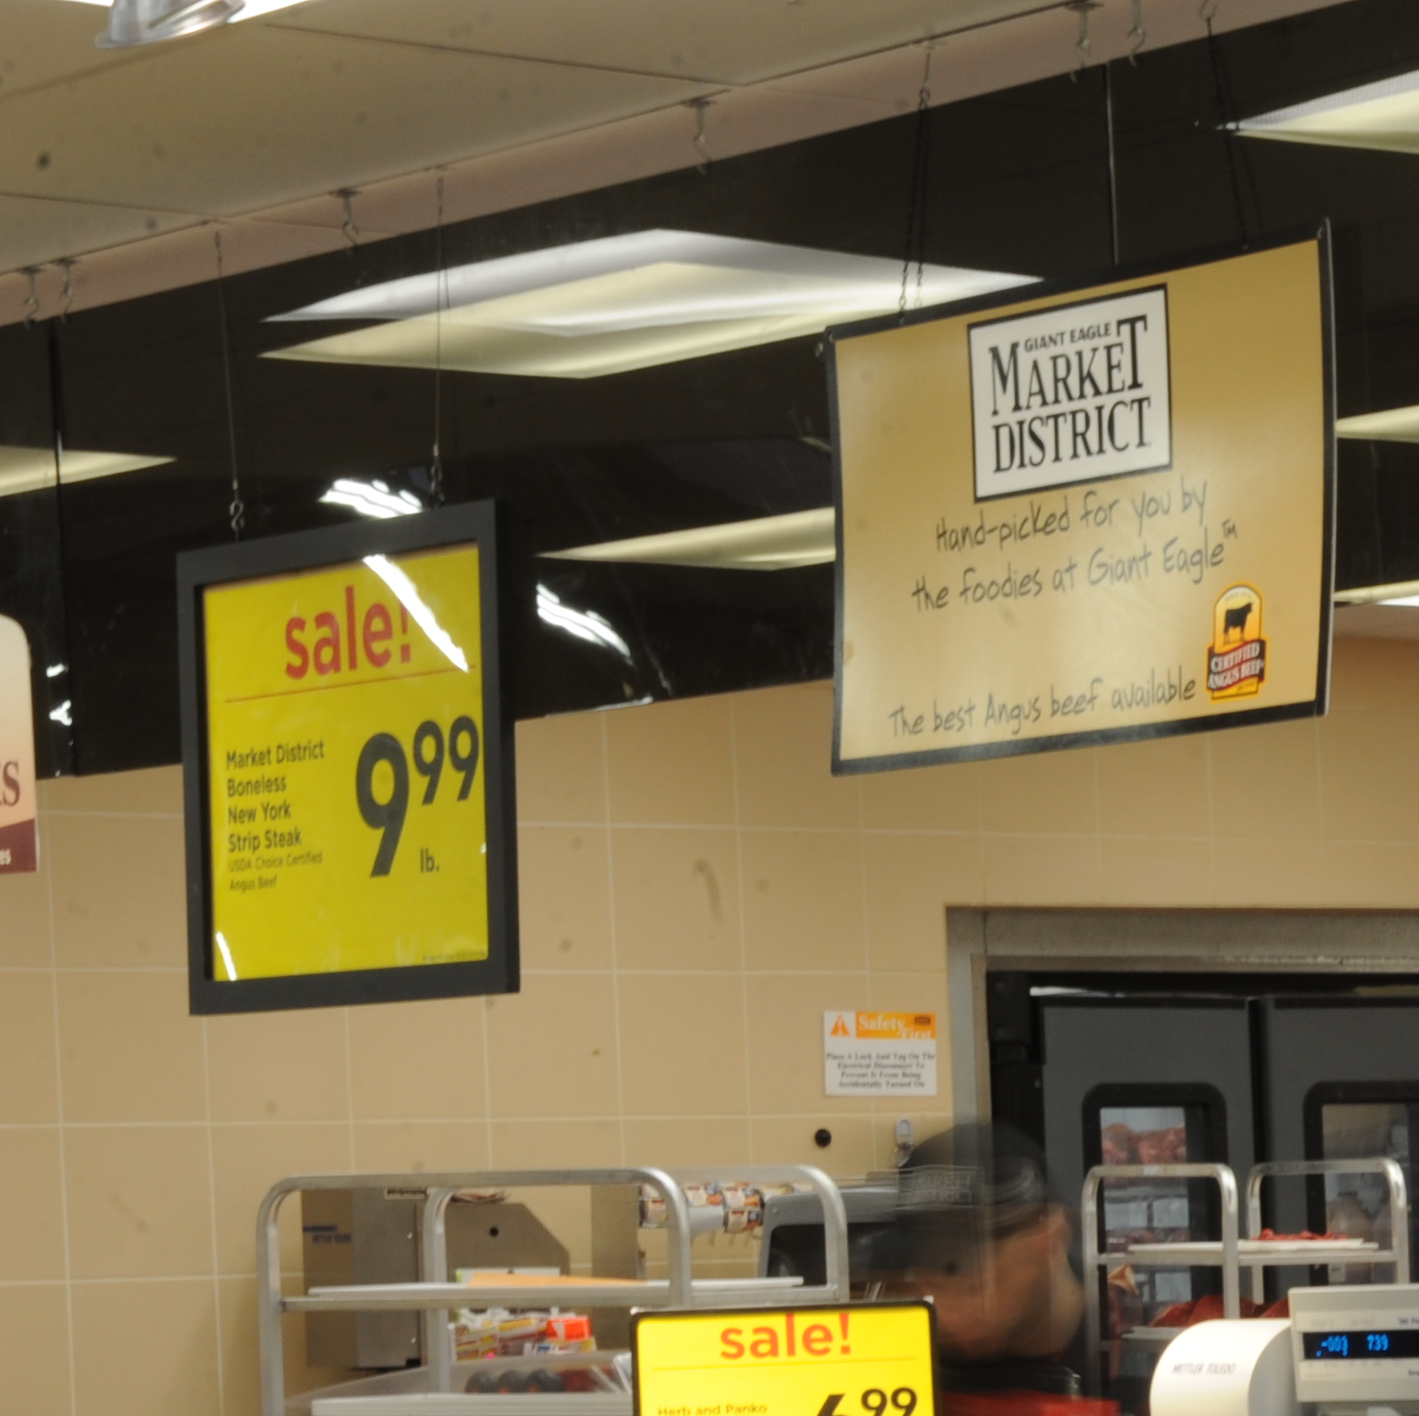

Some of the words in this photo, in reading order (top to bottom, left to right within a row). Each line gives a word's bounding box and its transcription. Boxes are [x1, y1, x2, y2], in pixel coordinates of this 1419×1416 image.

[1024, 329, 1067, 355] GIANT
[1068, 321, 1113, 349] EAGLE
[988, 314, 1148, 417] MARKET
[993, 396, 1152, 475] DISTRICT
[935, 494, 1071, 556] Hand-picked
[1081, 490, 1117, 528] for
[1133, 487, 1173, 536] you
[1180, 476, 1208, 523] by
[912, 578, 950, 615] the
[960, 565, 1044, 606] foodies
[1053, 563, 1078, 594] at
[1086, 546, 1153, 587] Giant
[285, 585, 411, 681] sale!
[889, 706, 924, 740] The
[933, 698, 976, 733] best
[983, 694, 1042, 735] Angus
[1049, 677, 1099, 719] beef
[1111, 666, 1197, 712] available
[226, 748, 272, 770] Market
[276, 740, 325, 764] District
[227, 775, 287, 798] Boneless
[228, 806, 257, 825] New
[261, 799, 291, 822] York
[229, 832, 261, 854] Strip
[265, 827, 302, 849] Steak
[419, 848, 440, 873] lb.
[859, 1014, 905, 1032] Safety
[720, 1313, 850, 1360] sale!
[658, 1406, 690, 1416] Herb
[695, 1405, 721, 1416] and
[726, 1403, 767, 1415] Panko
